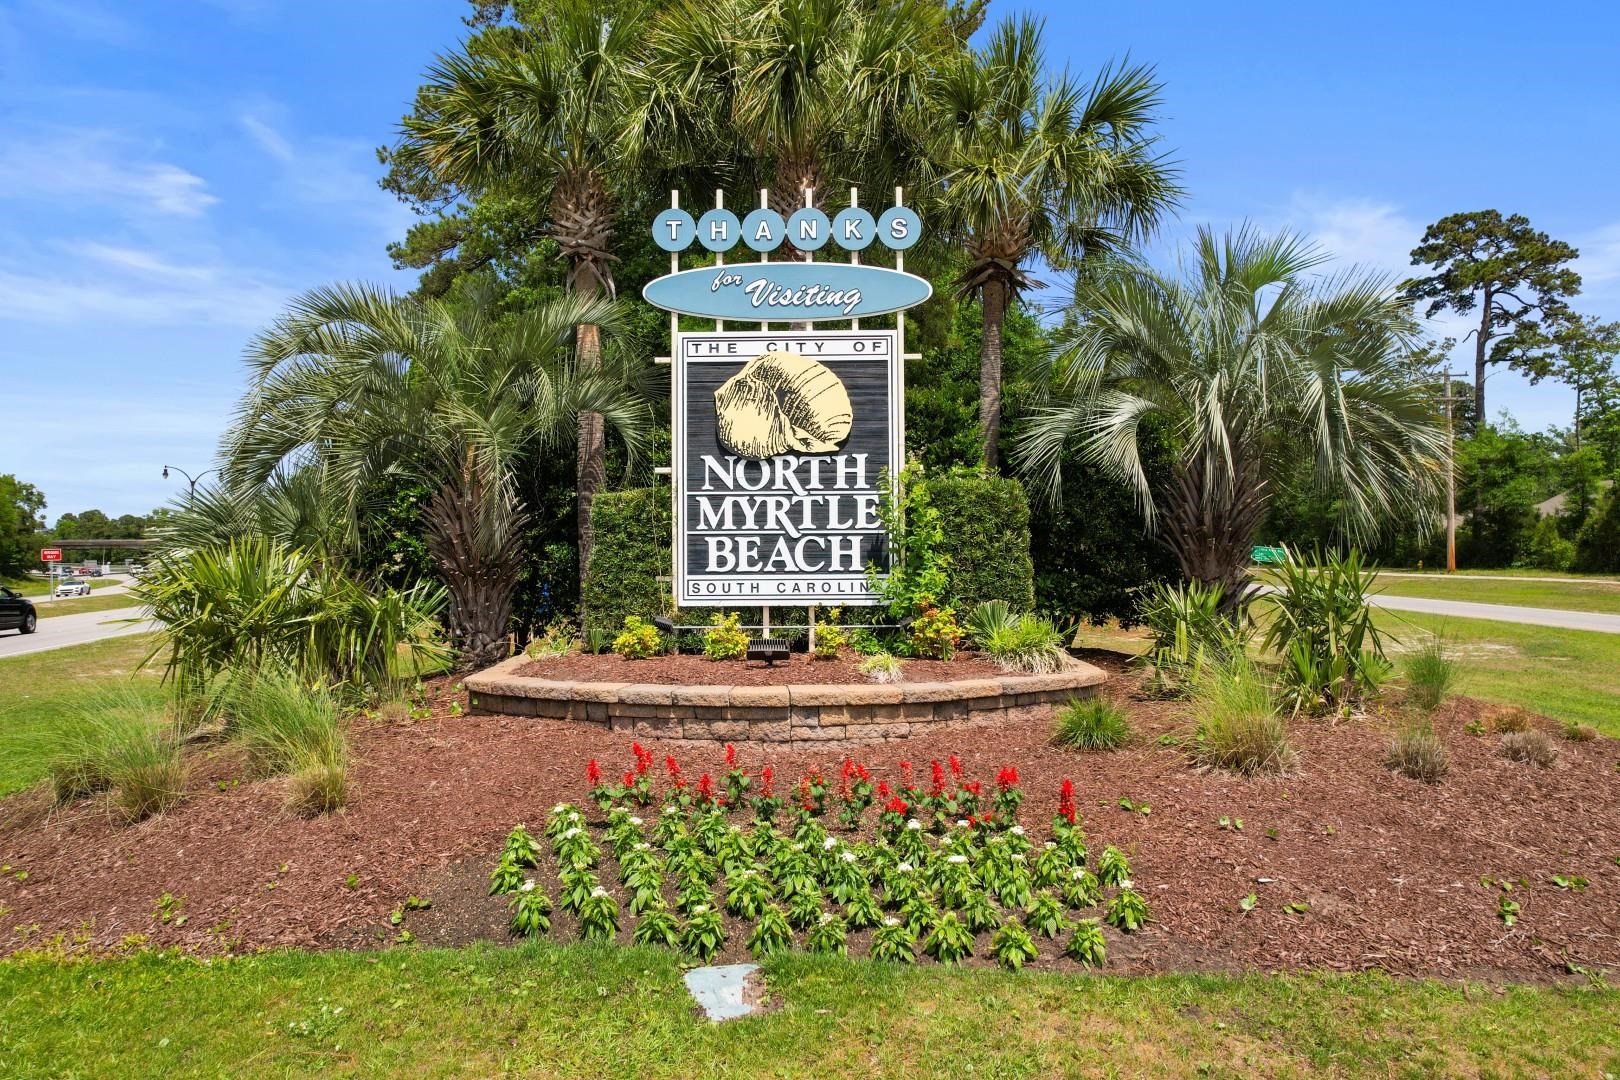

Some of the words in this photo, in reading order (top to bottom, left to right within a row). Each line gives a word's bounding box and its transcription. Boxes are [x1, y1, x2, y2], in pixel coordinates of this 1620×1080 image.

[666, 218, 908, 241] THANKS
[711, 270, 743, 291] for
[745, 278, 862, 315] Visiting
[692, 343, 738, 354] THE
[766, 342, 825, 353] CITY
[853, 341, 882, 352] OF
[700, 453, 871, 496] NORTH
[696, 494, 882, 539] MYRTLE
[704, 535, 865, 573] BEACH
[692, 582, 760, 594] SOUTH
[776, 582, 879, 593] CAROLIN
